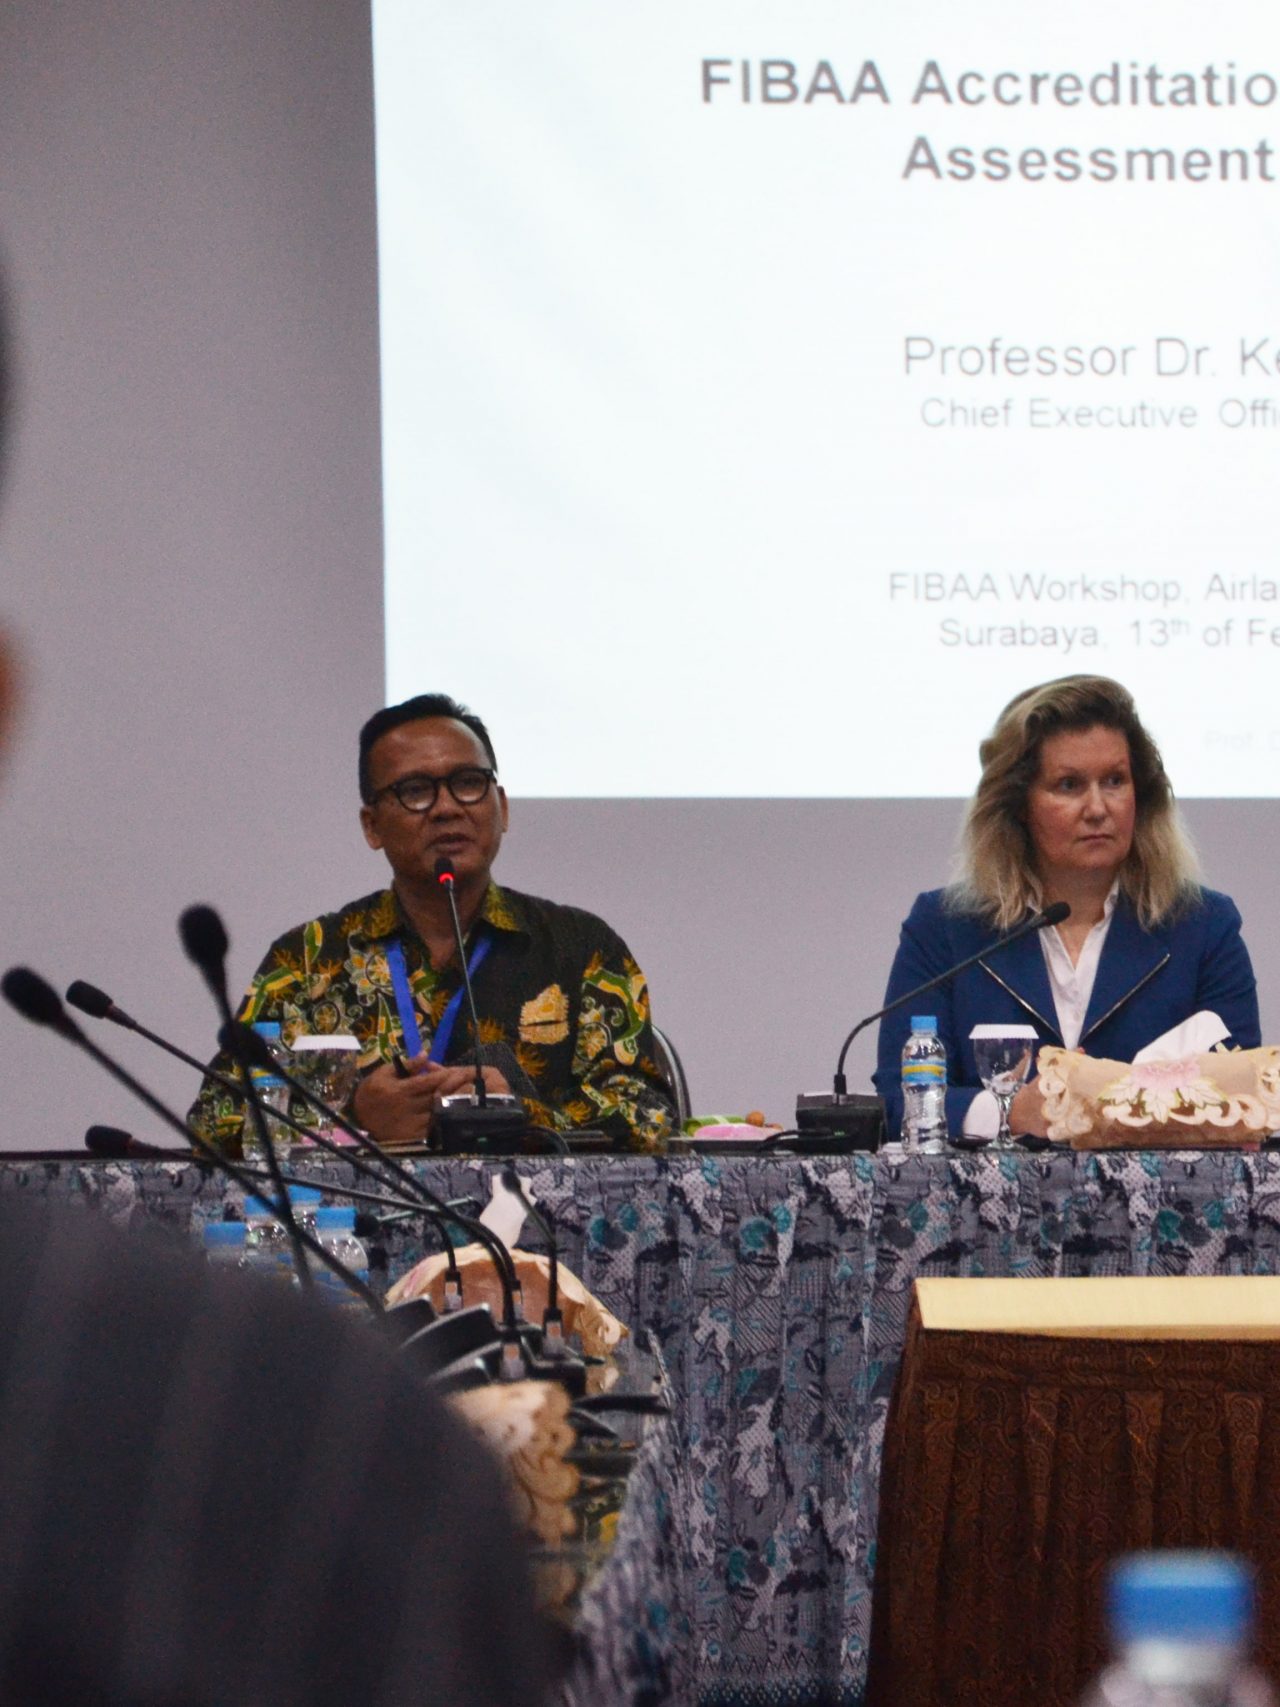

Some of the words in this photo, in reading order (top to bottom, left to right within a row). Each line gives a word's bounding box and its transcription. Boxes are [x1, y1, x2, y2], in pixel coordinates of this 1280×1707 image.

[701, 58, 891, 105] FIBAA
[901, 135, 1275, 183] Assessment
[903, 336, 1137, 378] Professor
[1154, 336, 1217, 378] Dr.
[920, 397, 1014, 429] Chief
[1028, 397, 1199, 429] Executive
[888, 571, 1001, 603] FIBAA
[939, 617, 1108, 655] Surabaya,
[1129, 617, 1190, 648] 13th
[1202, 617, 1235, 648] of
